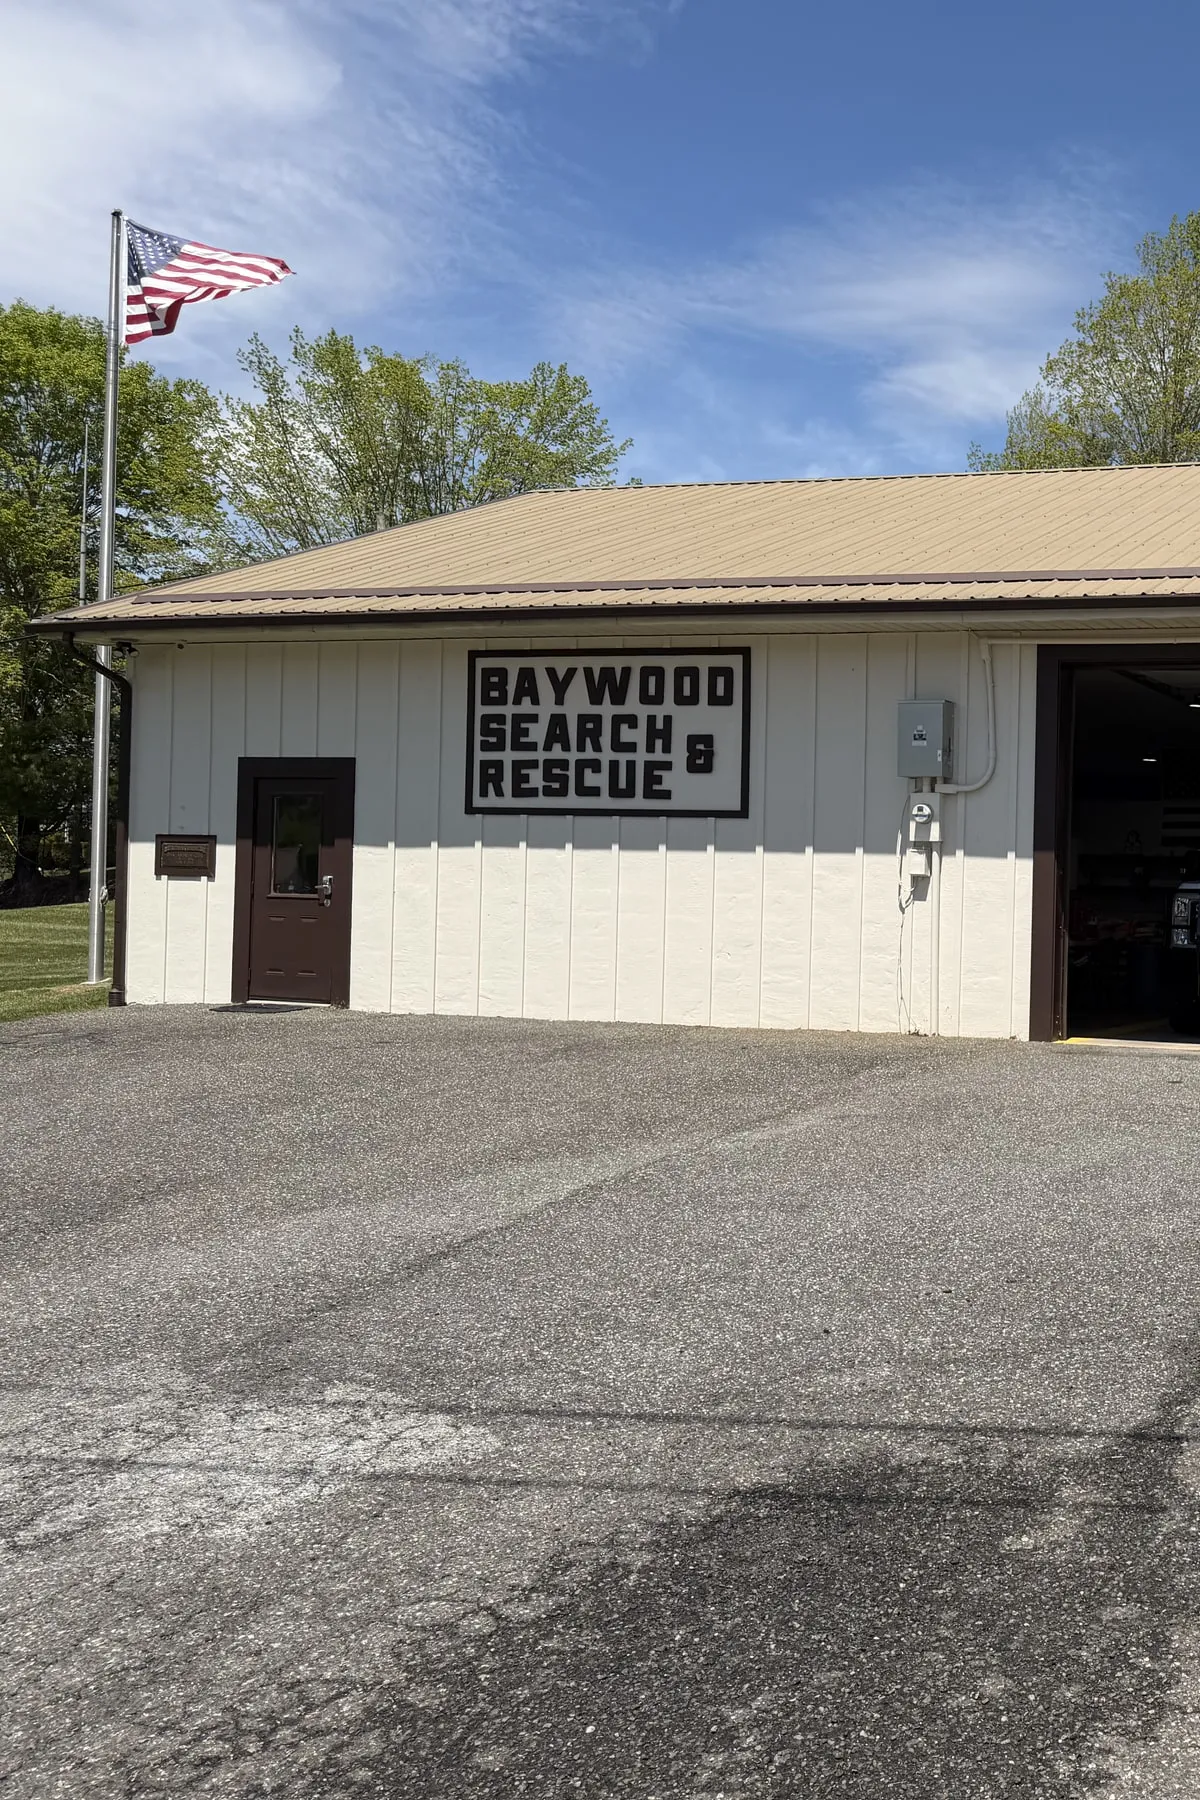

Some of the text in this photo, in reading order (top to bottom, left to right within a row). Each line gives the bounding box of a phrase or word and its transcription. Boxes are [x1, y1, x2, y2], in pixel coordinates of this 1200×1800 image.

[480, 666, 734, 706] BAYWOOD
[480, 713, 714, 774] SEARCH &
[479, 758, 673, 800] RESCUE
